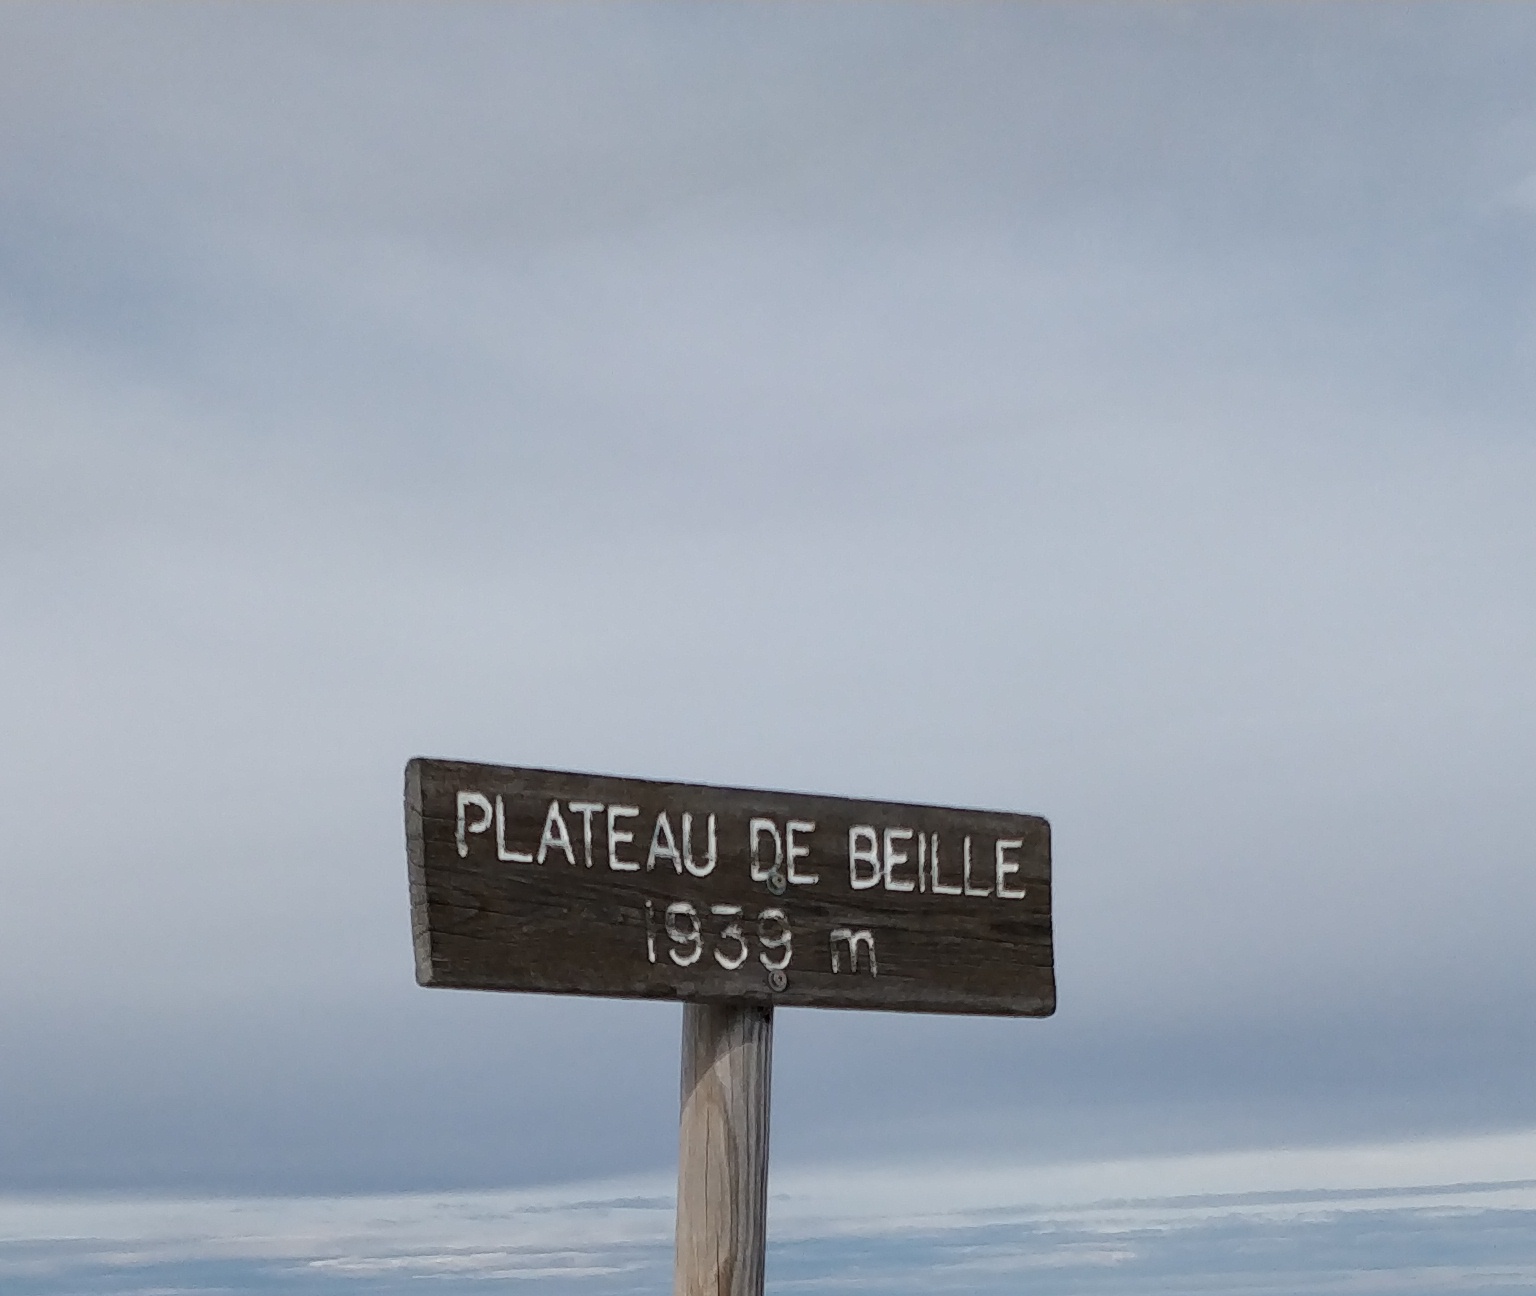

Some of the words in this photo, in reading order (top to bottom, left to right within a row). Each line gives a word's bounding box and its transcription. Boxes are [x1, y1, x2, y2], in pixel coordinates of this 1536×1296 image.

[455, 790, 717, 878] PLATEAU
[749, 817, 820, 886] DE
[848, 824, 1027, 900] BEILLE
[644, 899, 794, 970] 1939
[829, 926, 879, 978] m
